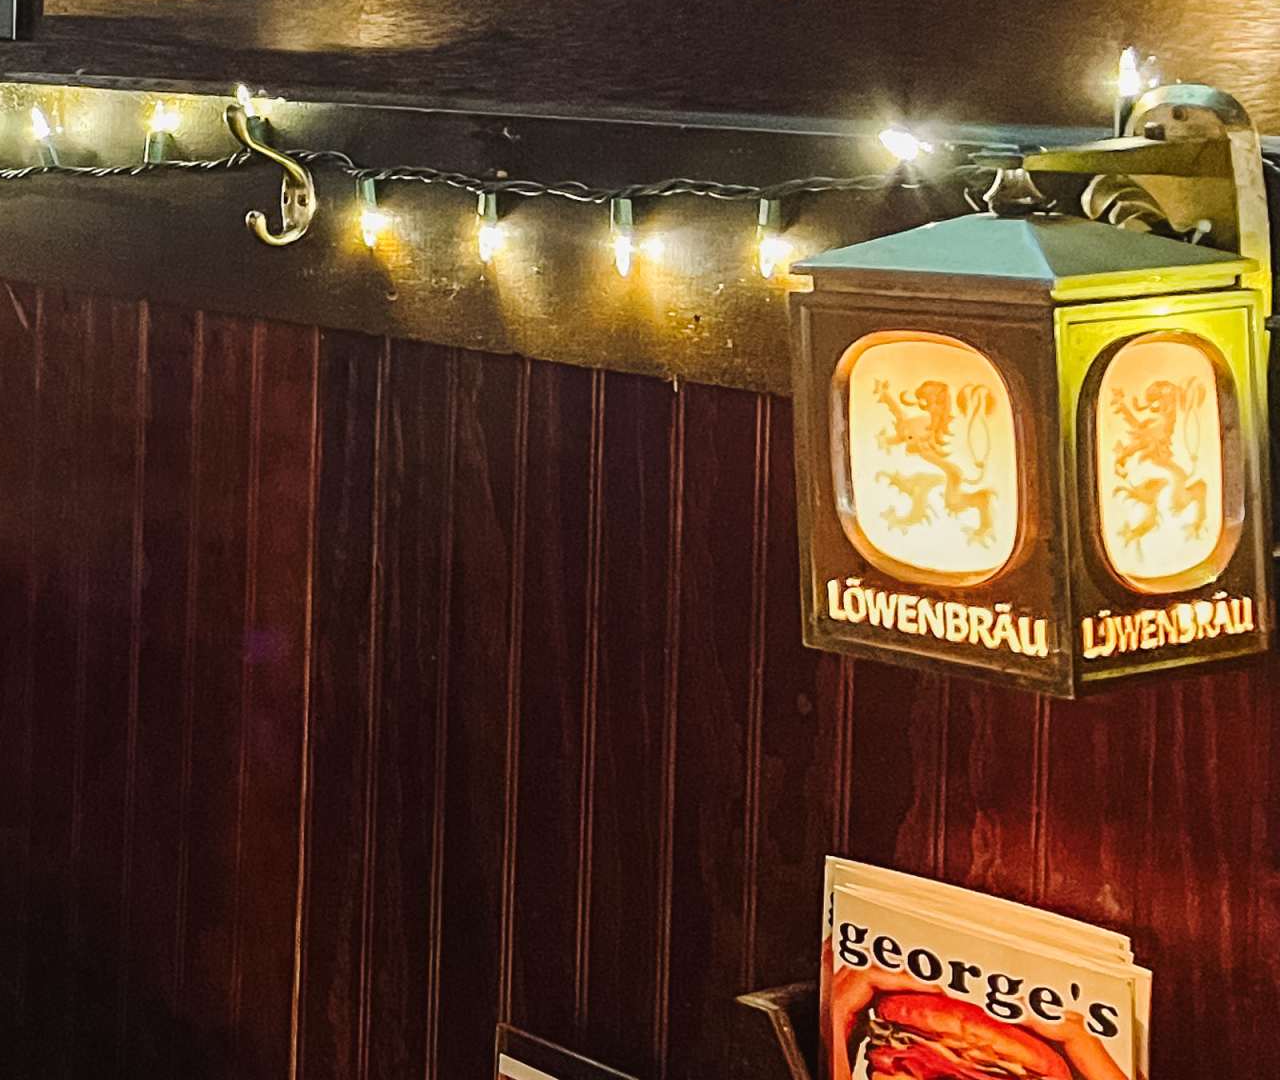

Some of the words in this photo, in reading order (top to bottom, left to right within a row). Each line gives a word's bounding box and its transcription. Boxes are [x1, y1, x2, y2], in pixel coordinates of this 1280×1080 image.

[826, 577, 1049, 657] LÖWENBRÄU
[1081, 591, 1255, 659] LÖWENBRÄU
[838, 920, 1119, 1039] george's
